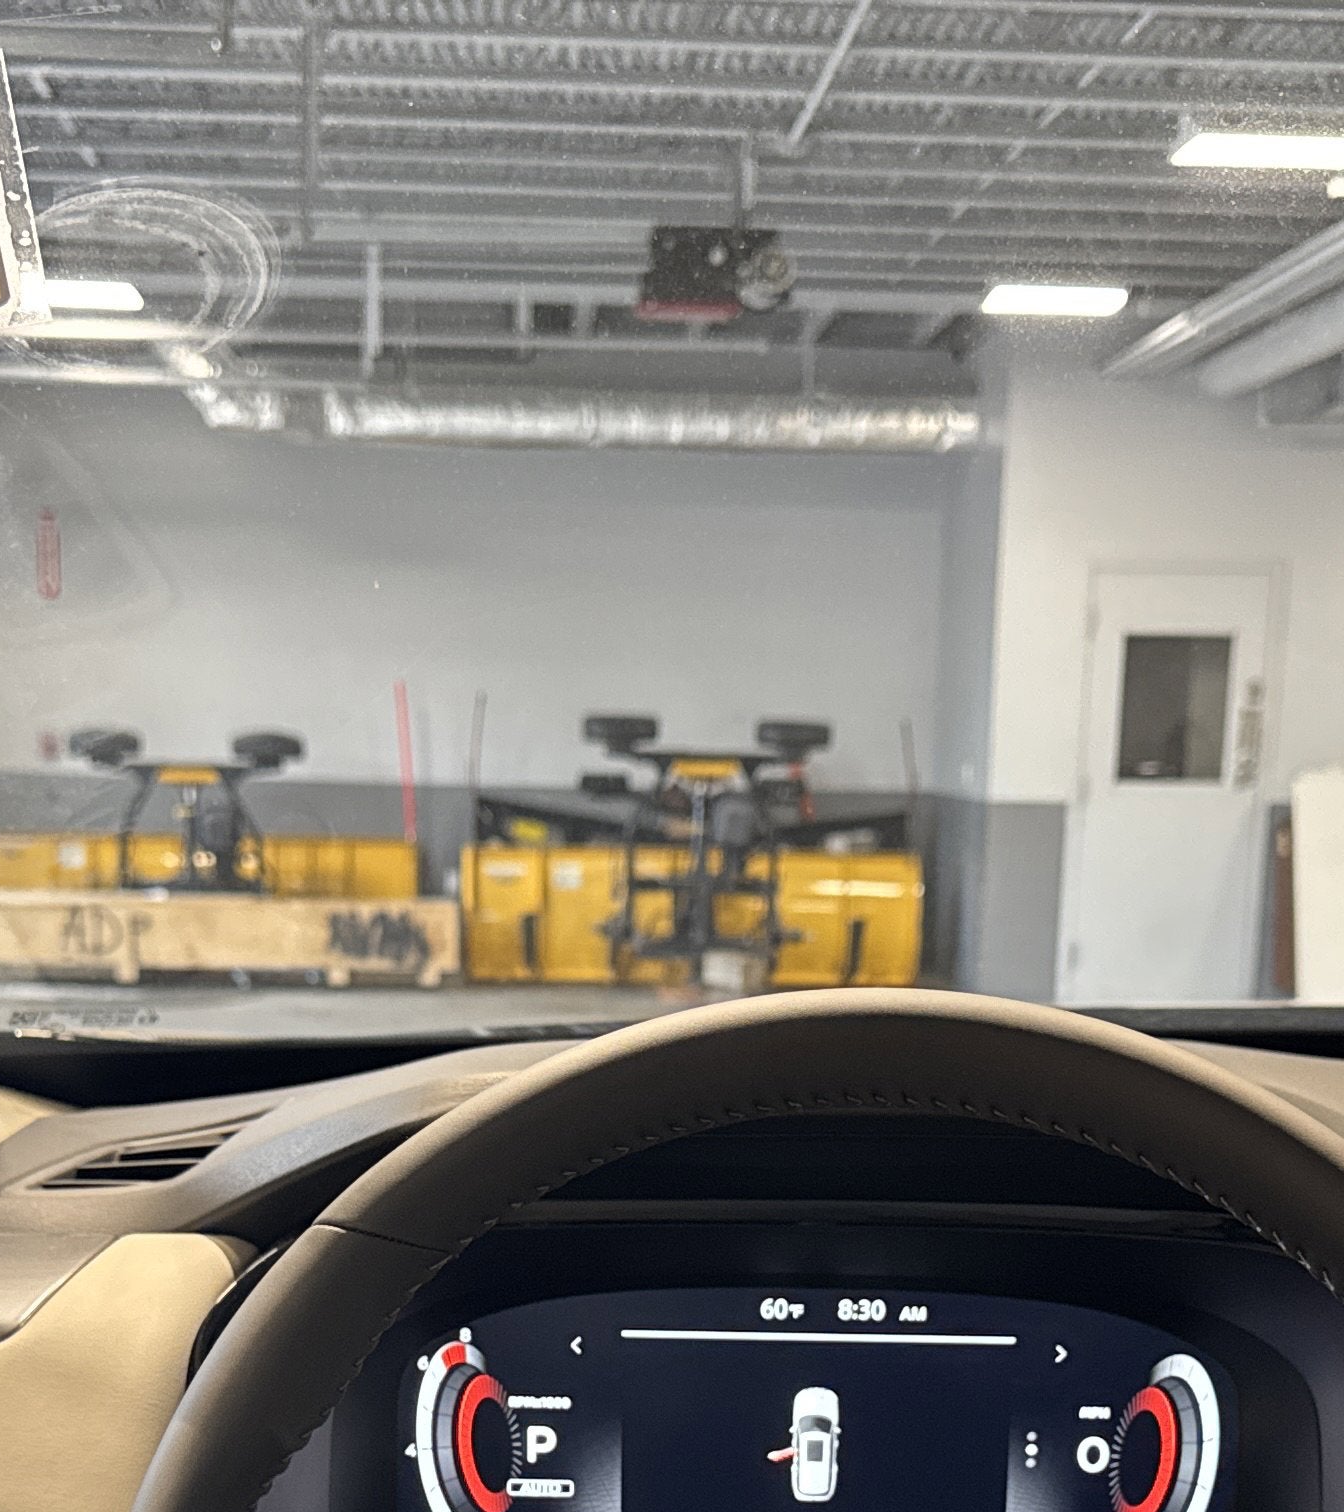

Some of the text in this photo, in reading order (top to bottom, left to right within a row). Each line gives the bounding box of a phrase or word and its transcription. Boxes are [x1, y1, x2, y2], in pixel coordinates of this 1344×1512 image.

[836, 1298, 887, 1322] 8:30
[898, 1305, 929, 1322] AM
[459, 1326, 472, 1343] 8
[416, 1355, 430, 1371] 6
[525, 1425, 558, 1464] P
